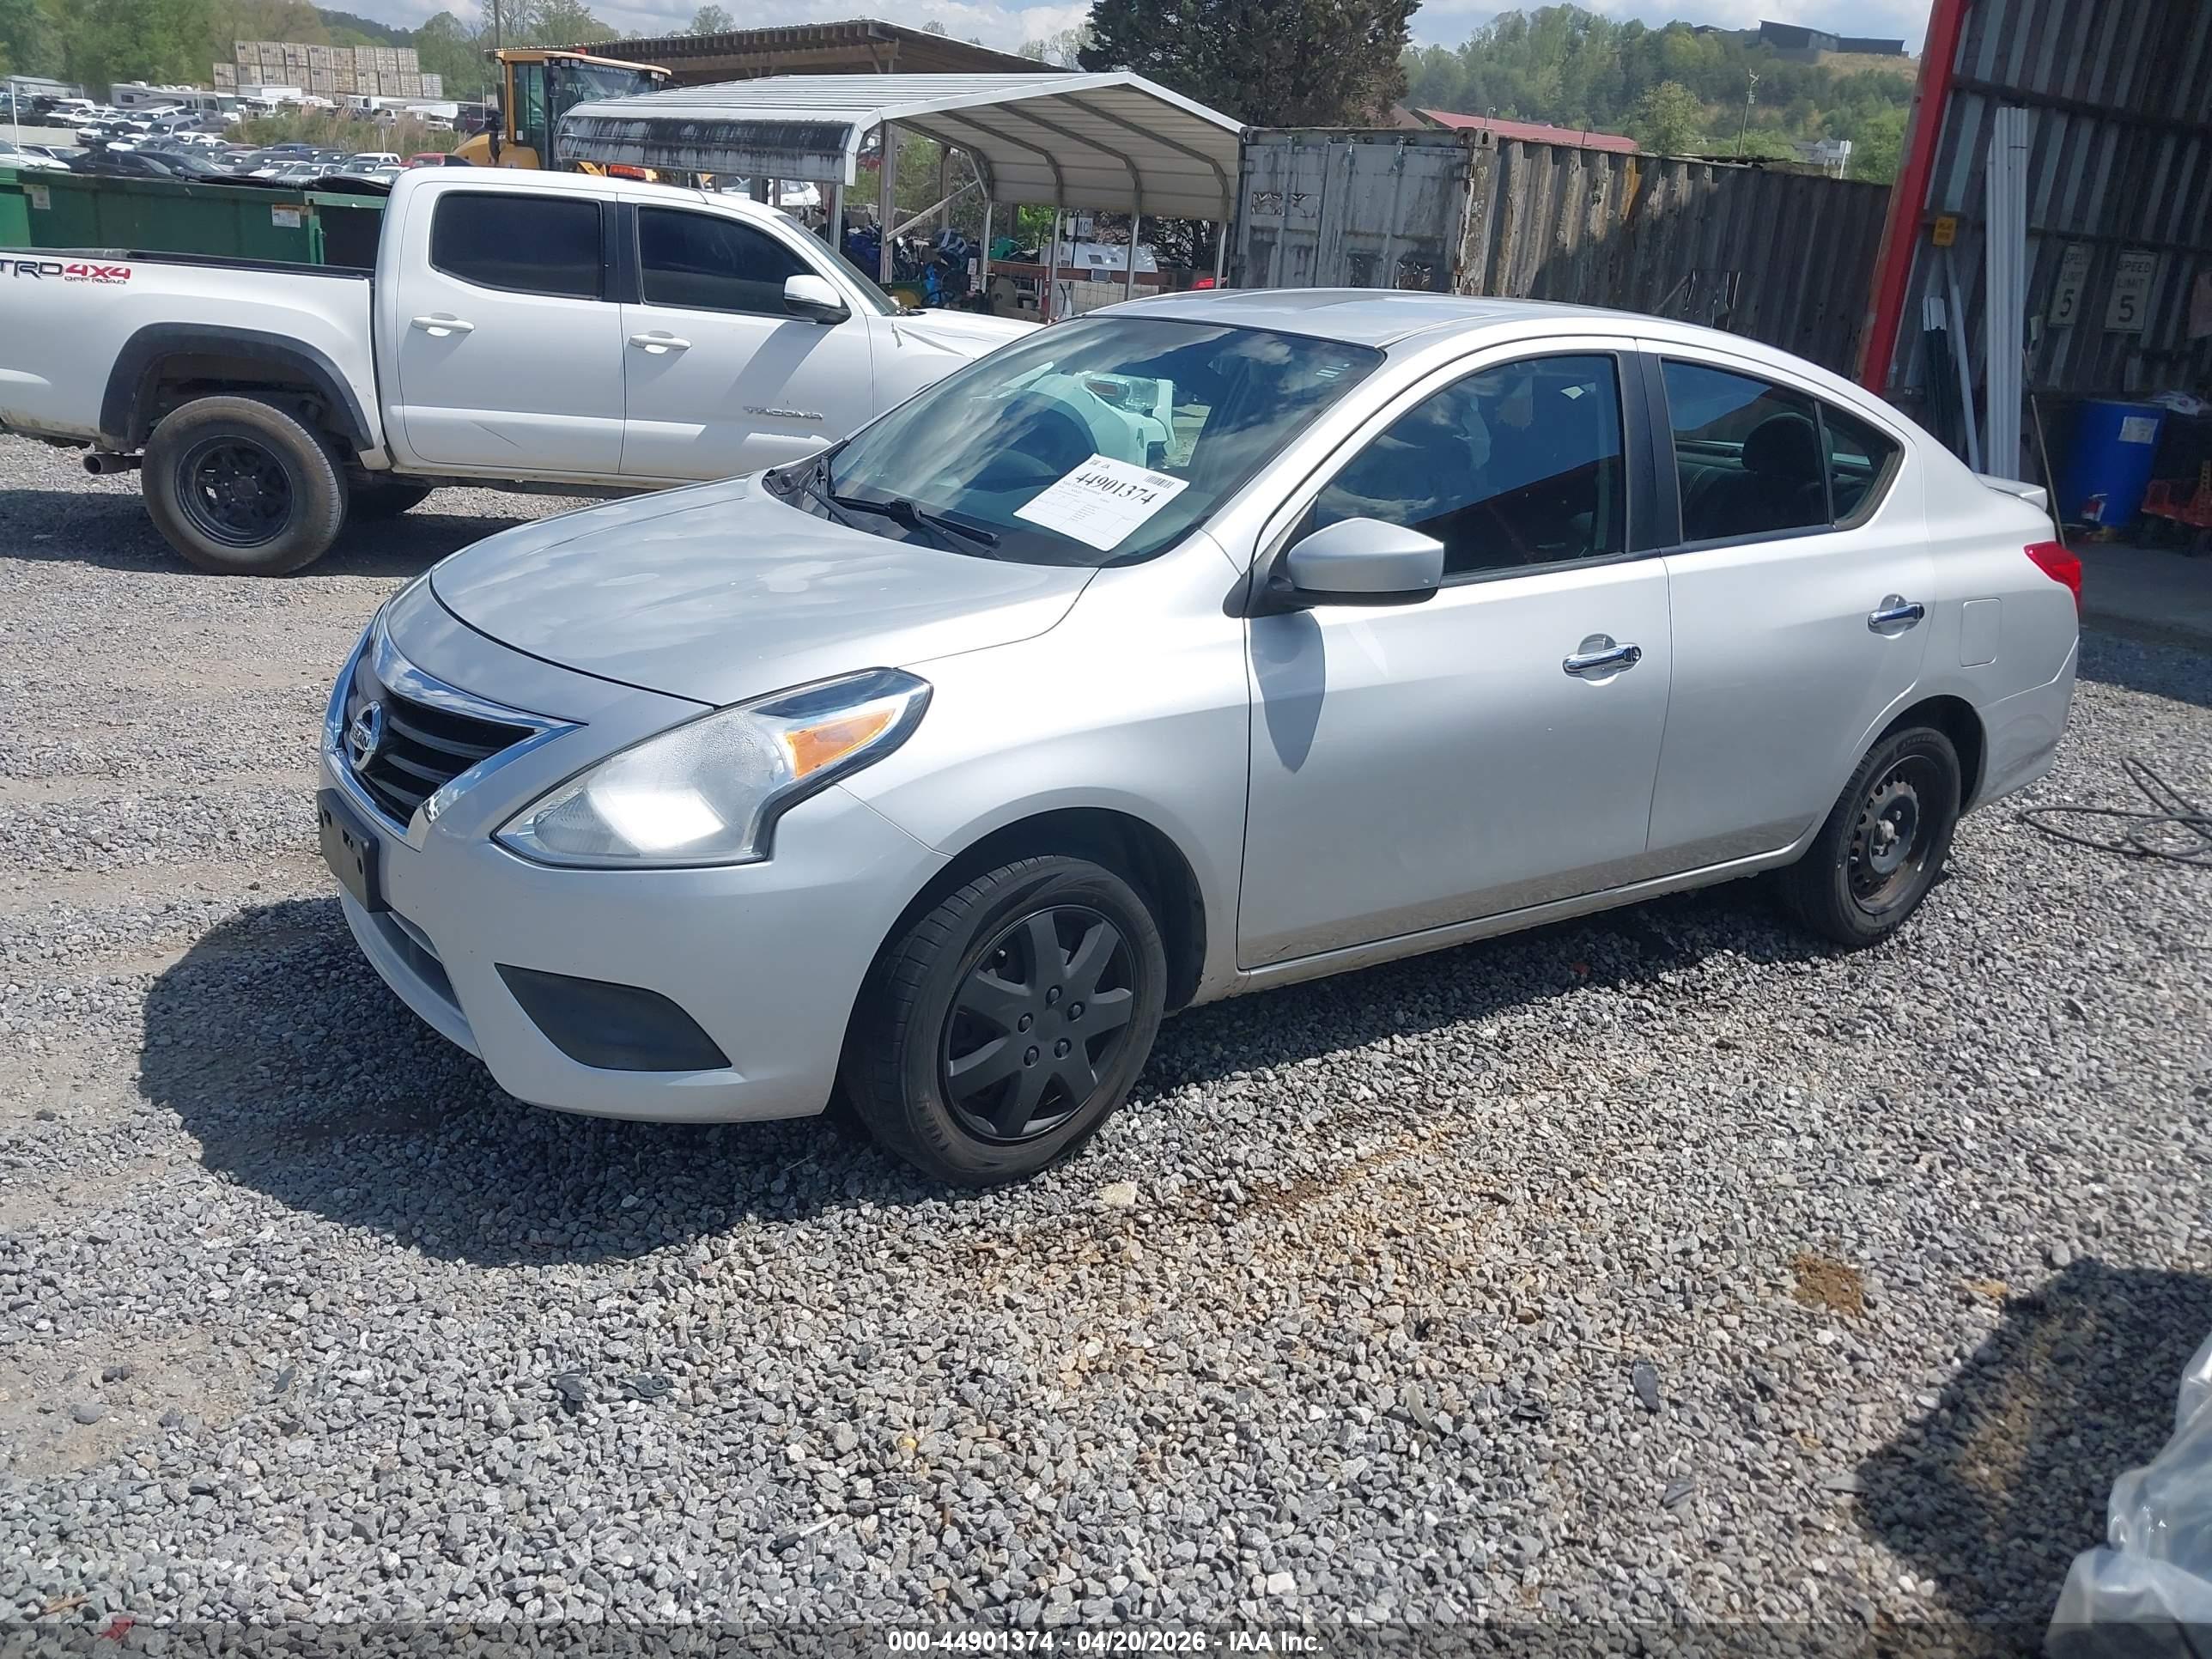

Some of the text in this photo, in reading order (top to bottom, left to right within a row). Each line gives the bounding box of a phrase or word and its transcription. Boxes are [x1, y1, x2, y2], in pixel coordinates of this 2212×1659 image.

[2117, 260, 2151, 273] SPEED
[64, 275, 127, 285] OFF ROAD
[2116, 277, 2146, 289] LIMIT
[2059, 289, 2075, 318] 5
[2118, 295, 2136, 322] 5
[1075, 471, 1158, 506] 44901374
